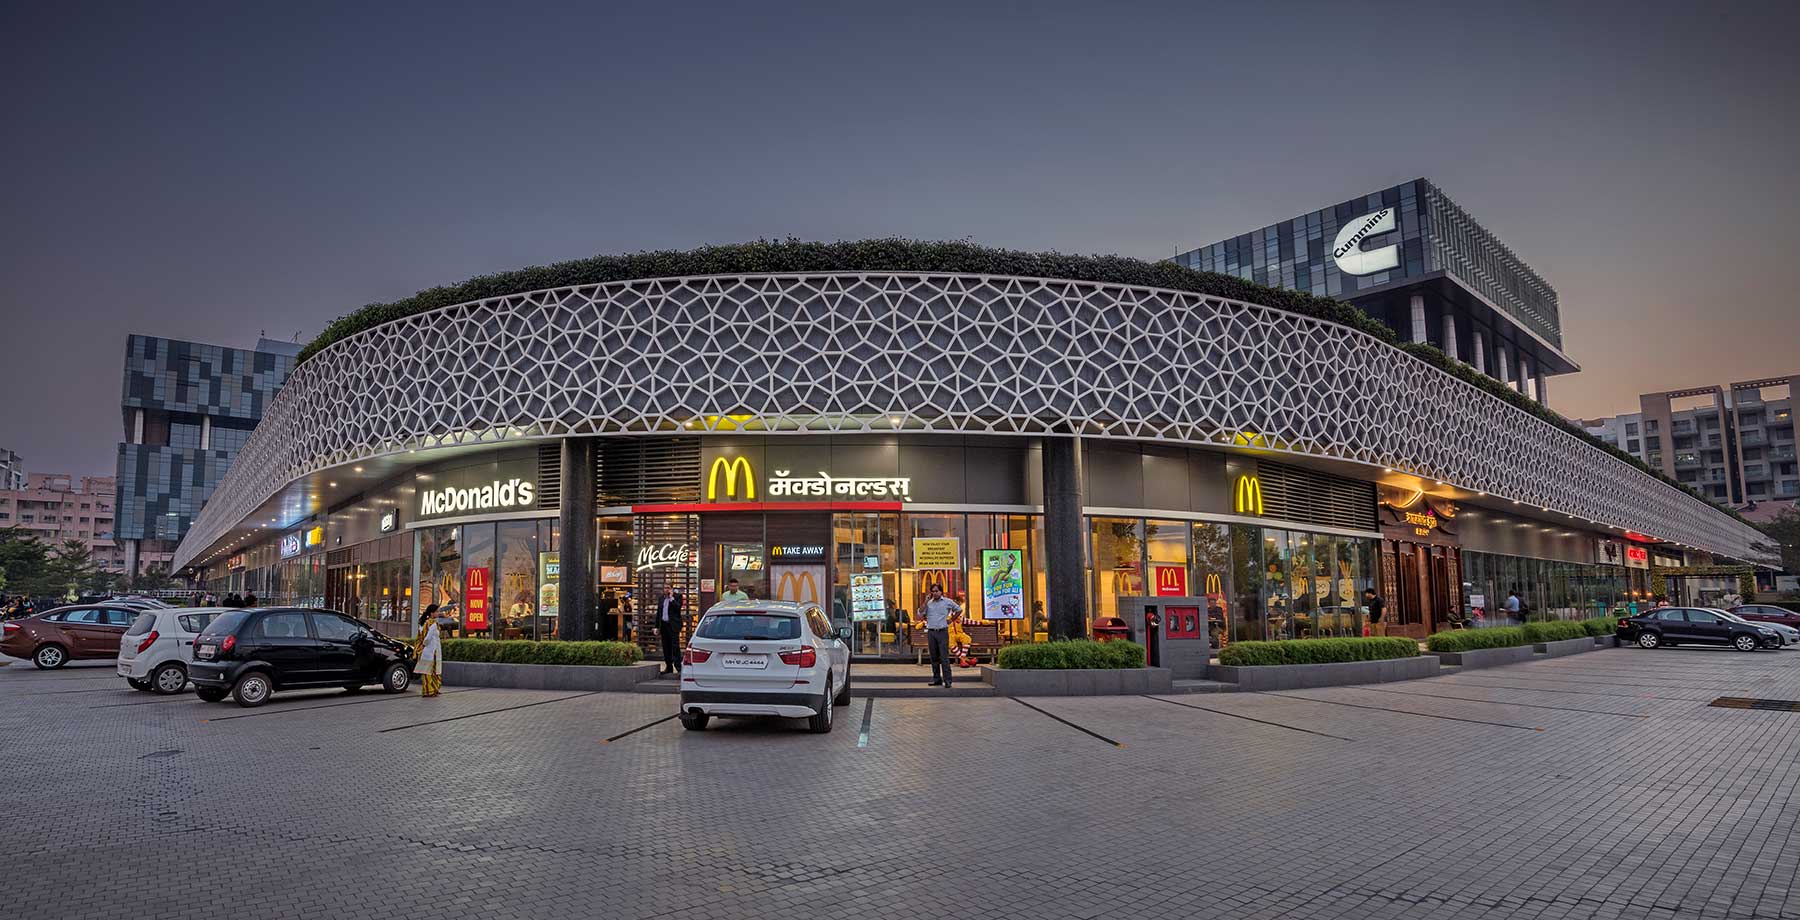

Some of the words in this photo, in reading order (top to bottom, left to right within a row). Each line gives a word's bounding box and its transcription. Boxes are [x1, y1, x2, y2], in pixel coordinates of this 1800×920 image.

[1333, 208, 1389, 258] Cummins
[421, 478, 533, 516] McDonald's
[782, 546, 800, 555] TAKE
[802, 546, 824, 555] AWAY
[470, 599, 484, 609] NOW
[469, 612, 484, 622] OPEN
